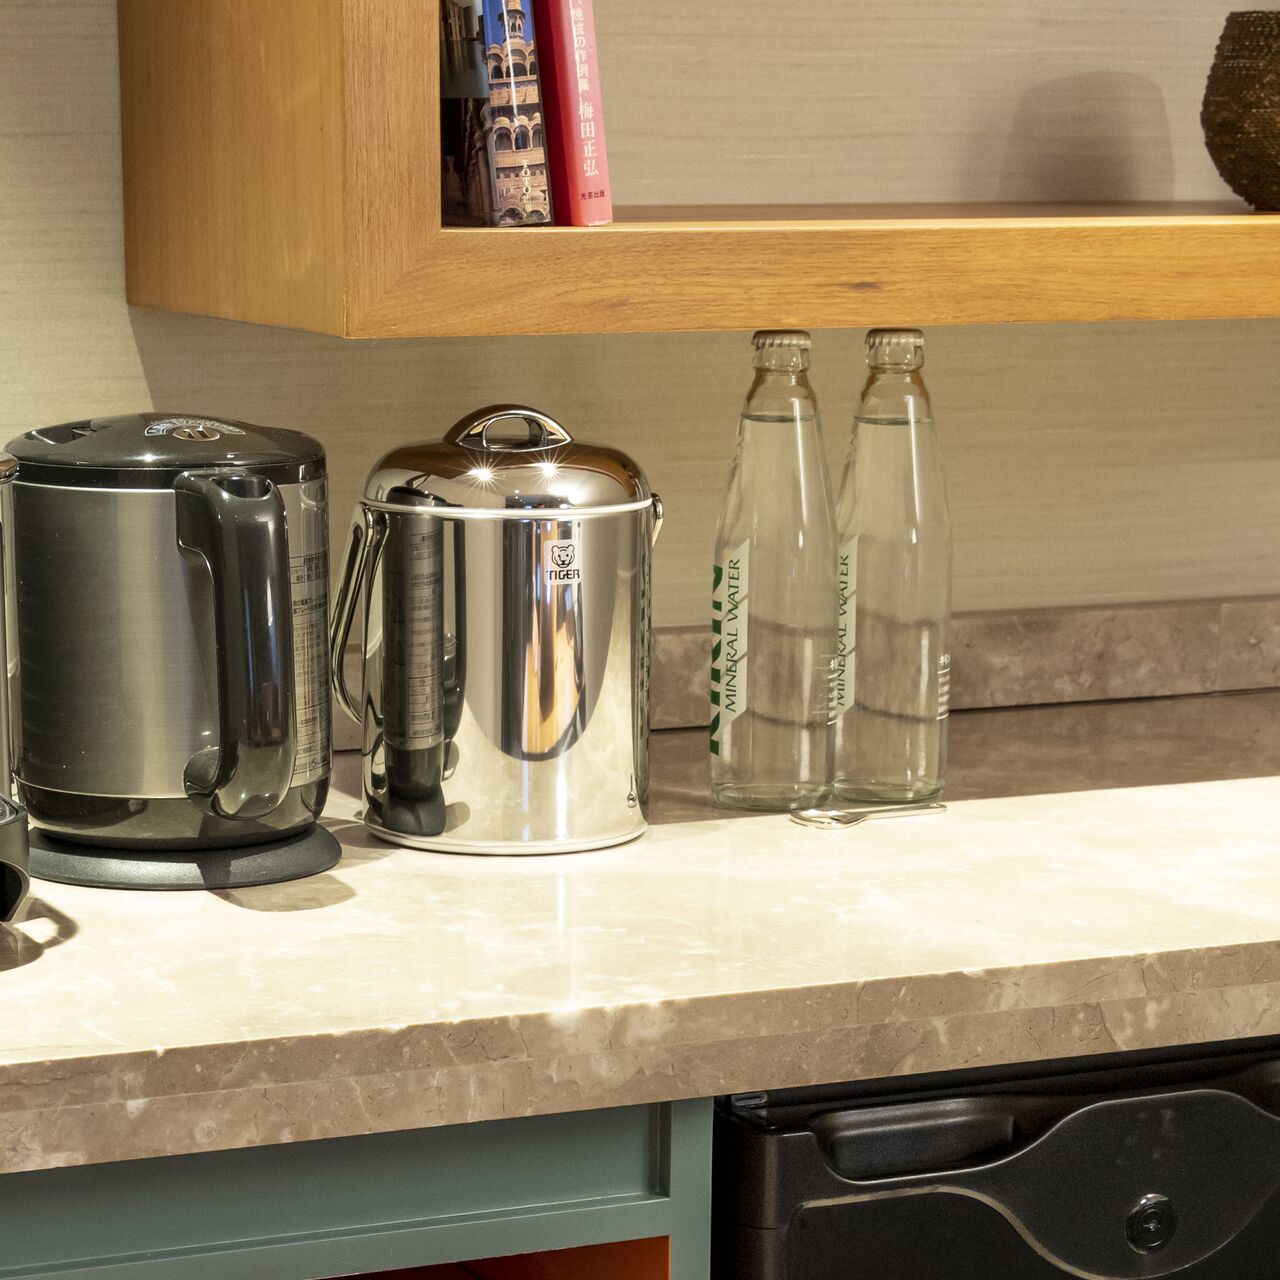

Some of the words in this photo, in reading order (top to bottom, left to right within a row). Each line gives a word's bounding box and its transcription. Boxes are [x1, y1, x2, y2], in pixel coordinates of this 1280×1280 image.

[547, 569, 580, 580] TIGER
[728, 558, 740, 622] WATER
[725, 627, 739, 712] MINERAL
